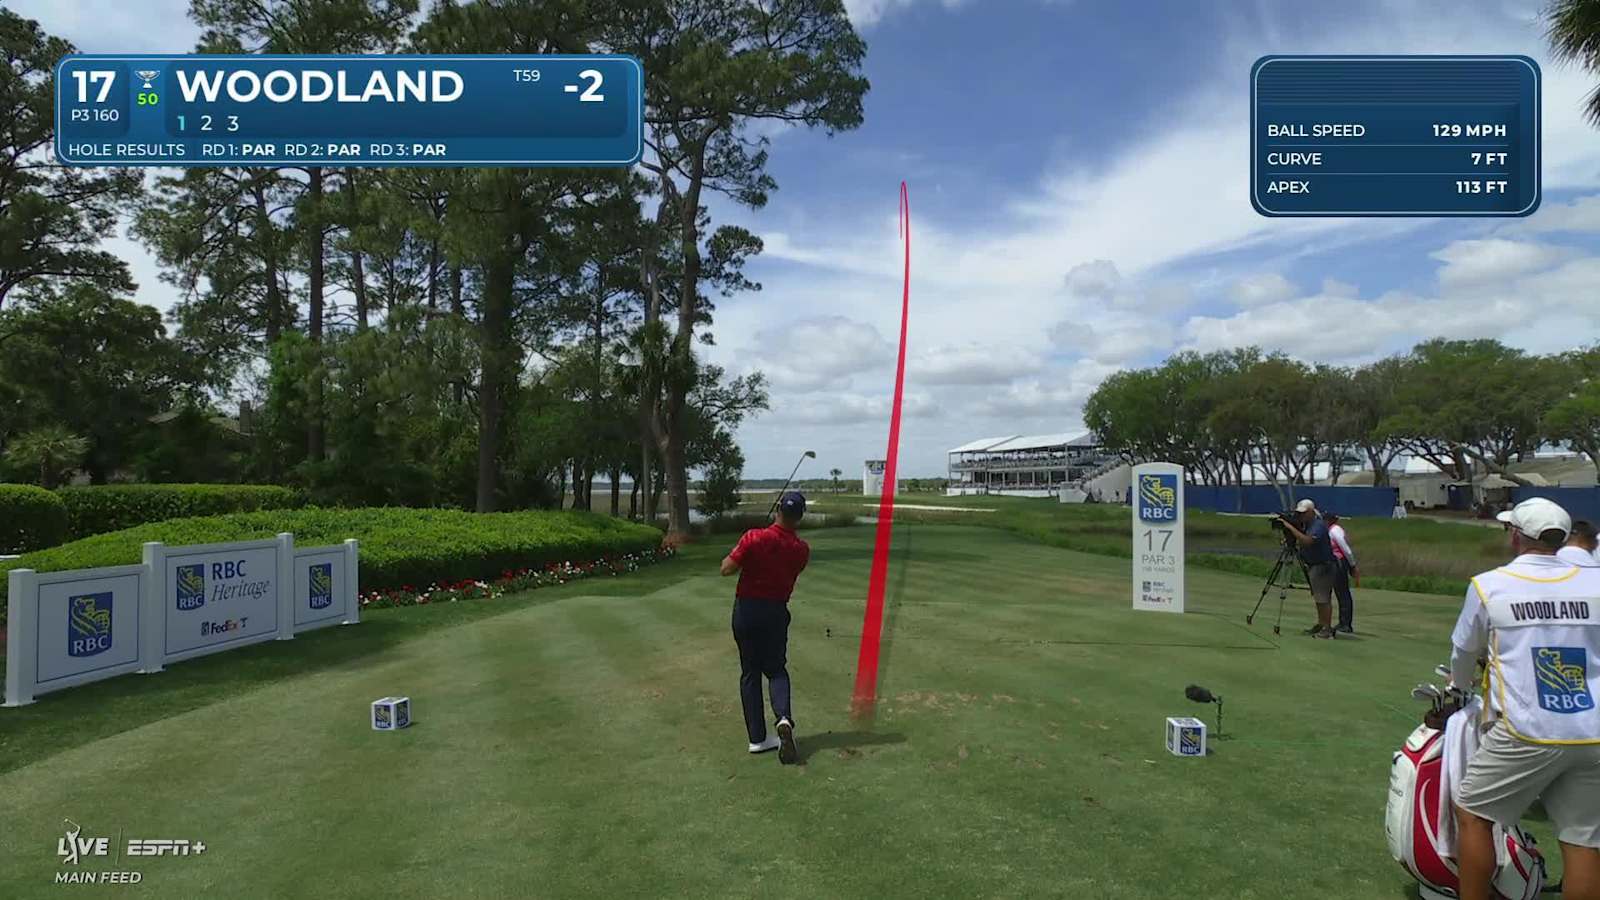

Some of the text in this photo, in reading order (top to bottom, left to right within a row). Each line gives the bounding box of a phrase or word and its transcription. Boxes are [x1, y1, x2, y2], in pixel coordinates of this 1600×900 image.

[1142, 508, 1174, 519] RBC
[1143, 530, 1173, 552] 17
[1142, 554, 1175, 565] PAR 3
[212, 560, 247, 581] RBC
[211, 579, 270, 602] Heritage
[179, 595, 203, 609] RBC
[311, 595, 329, 608] RBC
[1510, 601, 1590, 621] WOODLAND
[73, 635, 108, 655] RBC
[1543, 693, 1590, 709] RBC
